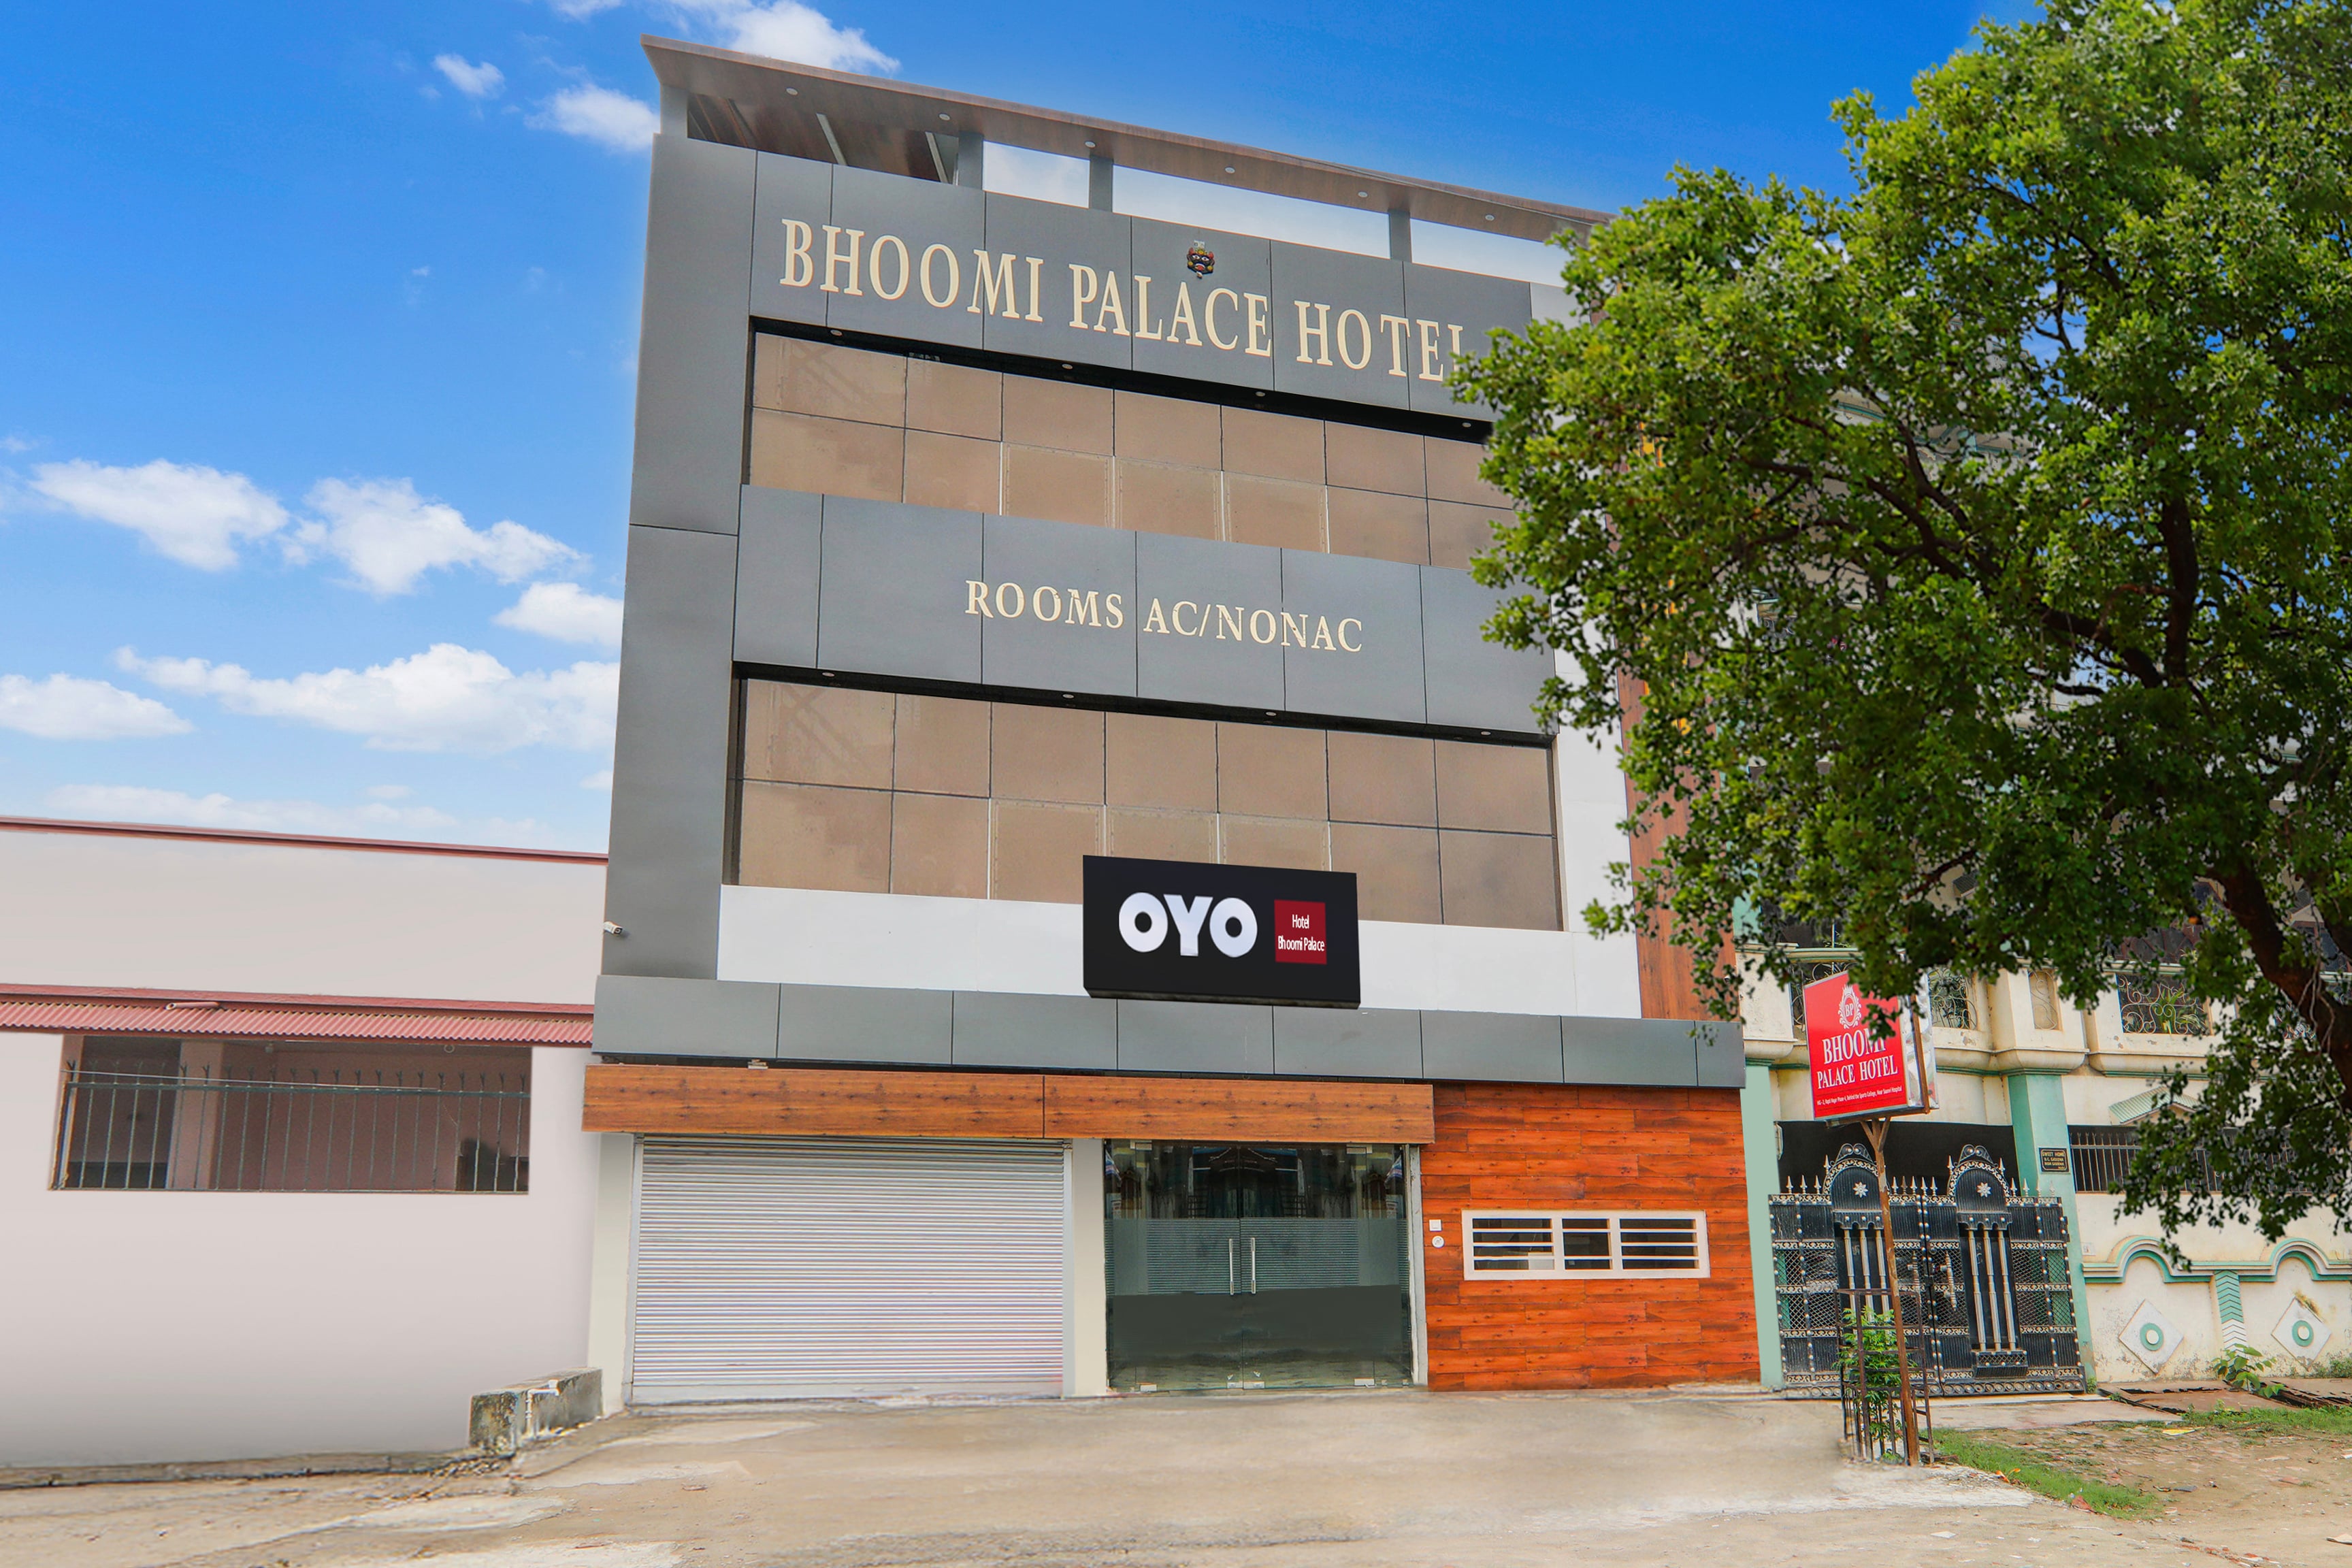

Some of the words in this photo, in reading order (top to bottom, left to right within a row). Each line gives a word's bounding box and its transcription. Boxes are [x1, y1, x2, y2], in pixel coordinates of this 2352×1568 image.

[779, 217, 1045, 323] BHOOMI
[1068, 263, 1272, 358] PALACE
[964, 579, 1124, 629] ROOMS
[1143, 598, 1363, 653] AC/NONAC
[1118, 892, 1258, 958] OYO
[1292, 914, 1310, 929] Hotel
[1277, 934, 1303, 951] Bhoomi
[1303, 936, 1325, 951] Palace
[1845, 1002, 1854, 1017] BP
[1816, 1064, 1856, 1090] PALACE
[1859, 1055, 1898, 1081] HOTEL
